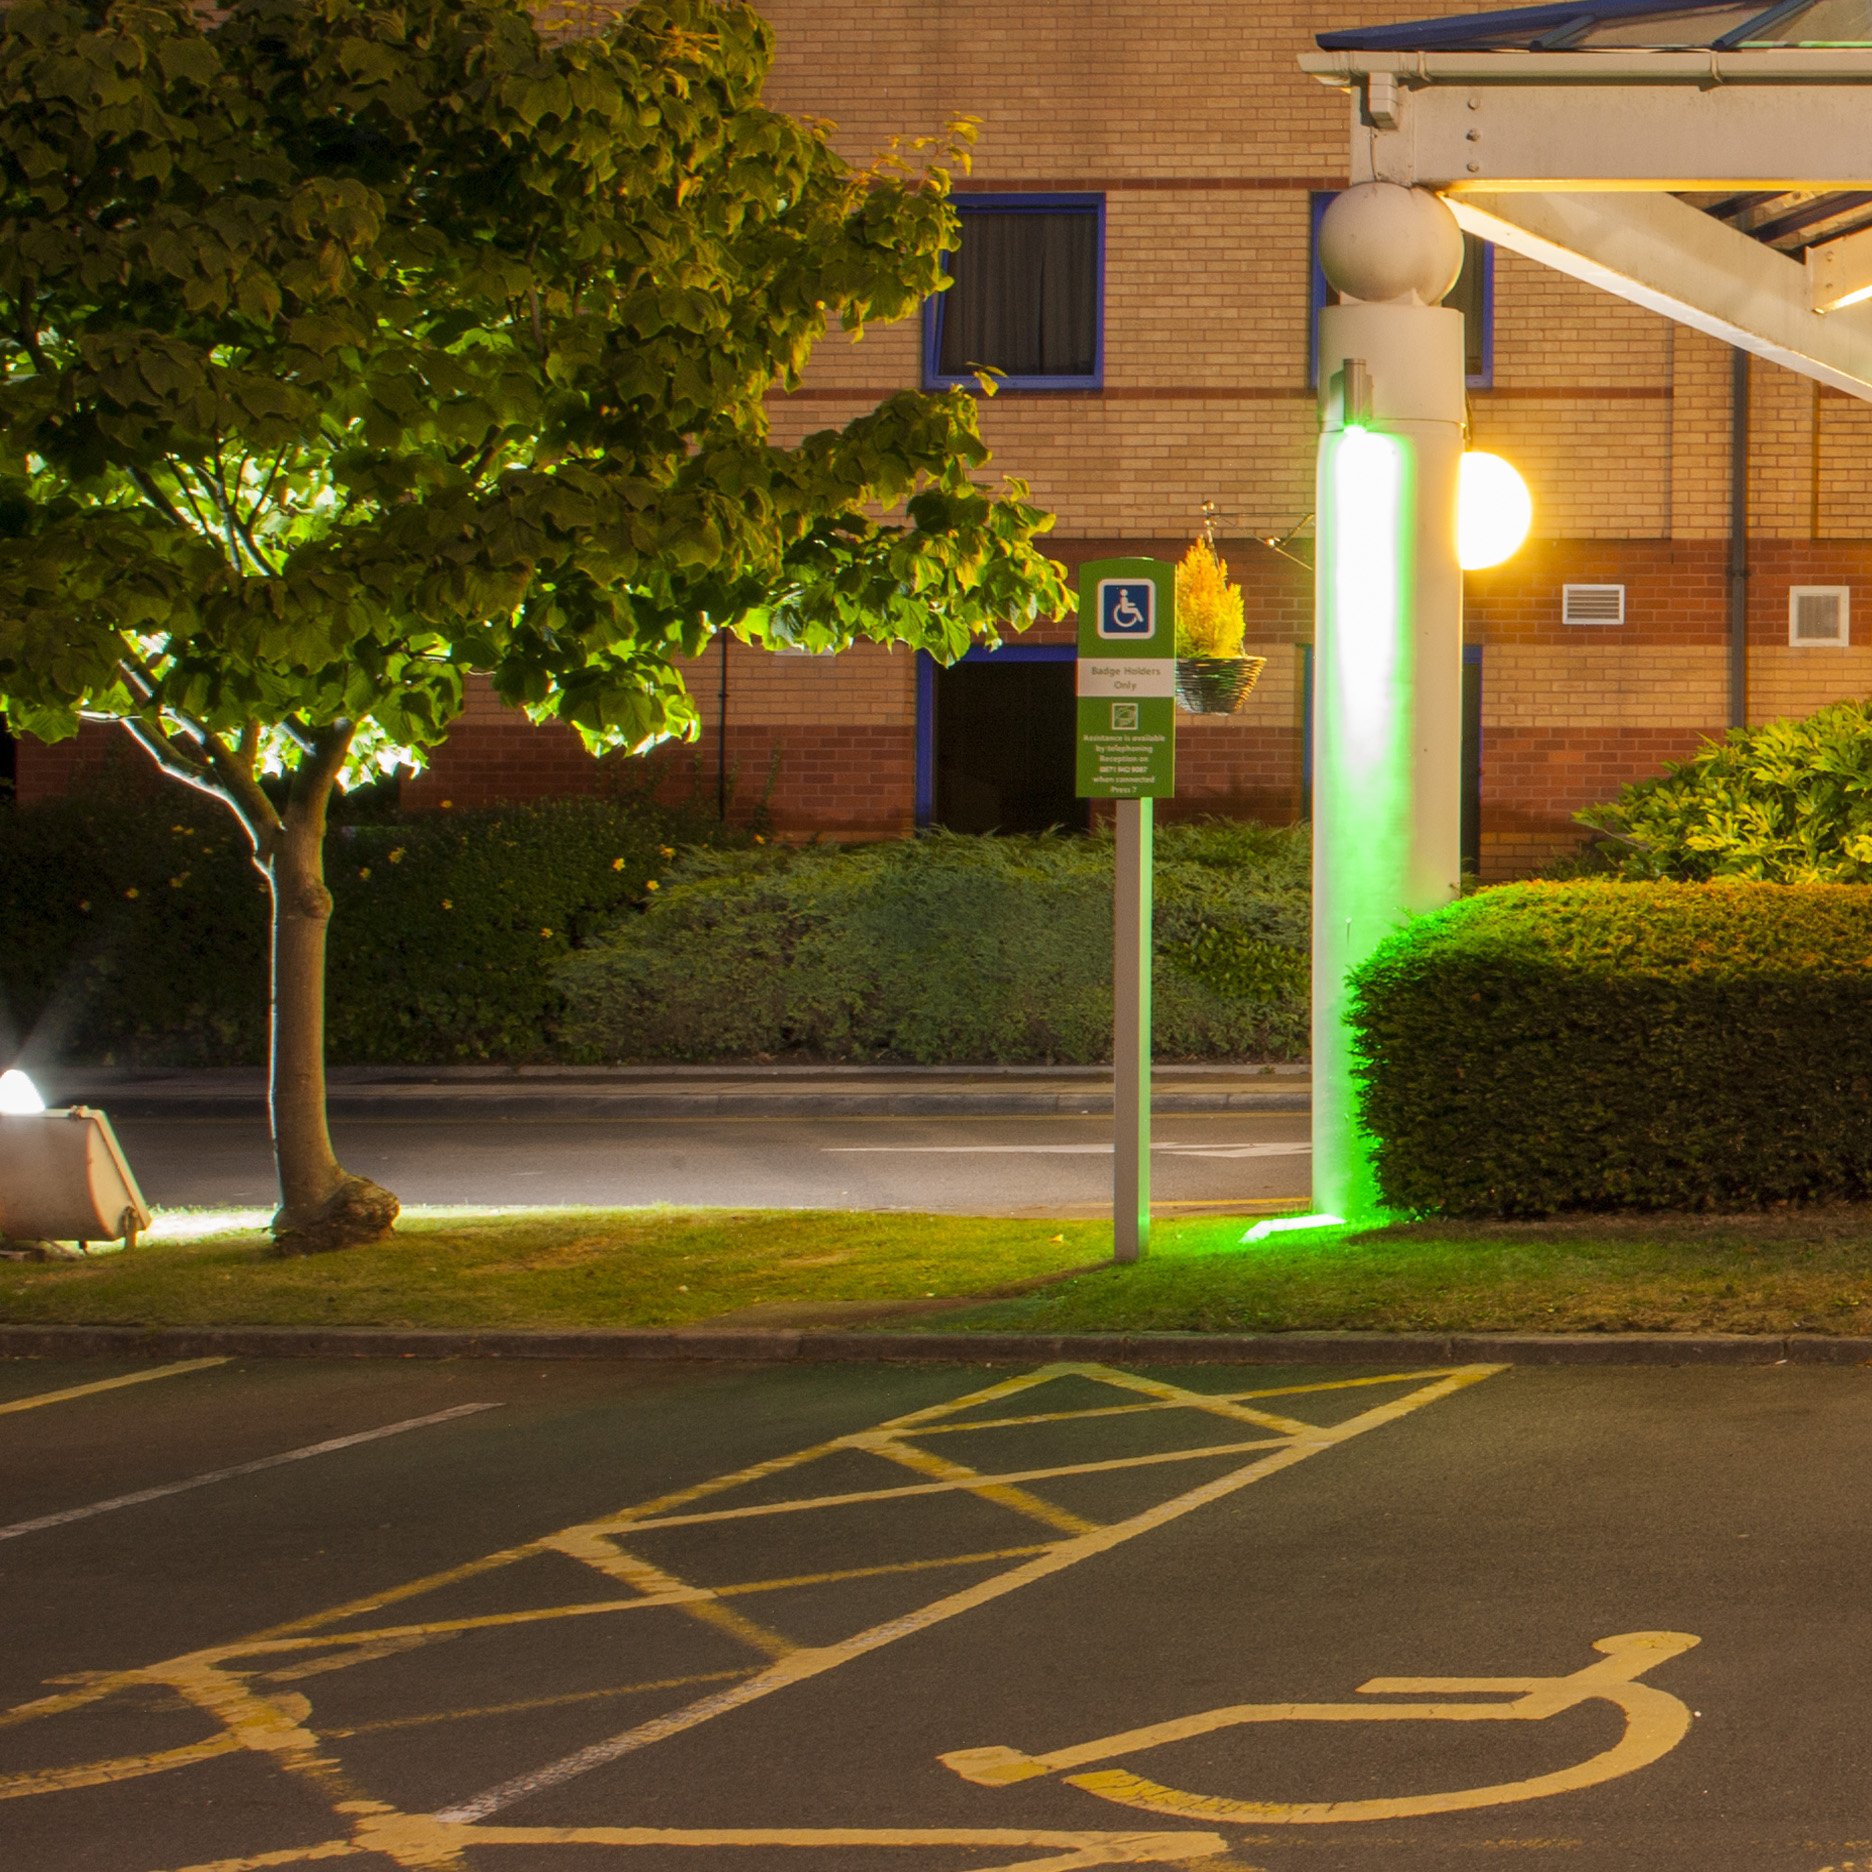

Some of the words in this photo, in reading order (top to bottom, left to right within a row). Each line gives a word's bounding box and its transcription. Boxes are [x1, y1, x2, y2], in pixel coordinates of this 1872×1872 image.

[1091, 666, 1121, 677] Badge
[1123, 666, 1161, 676] Holders
[1113, 680, 1137, 691] Only
